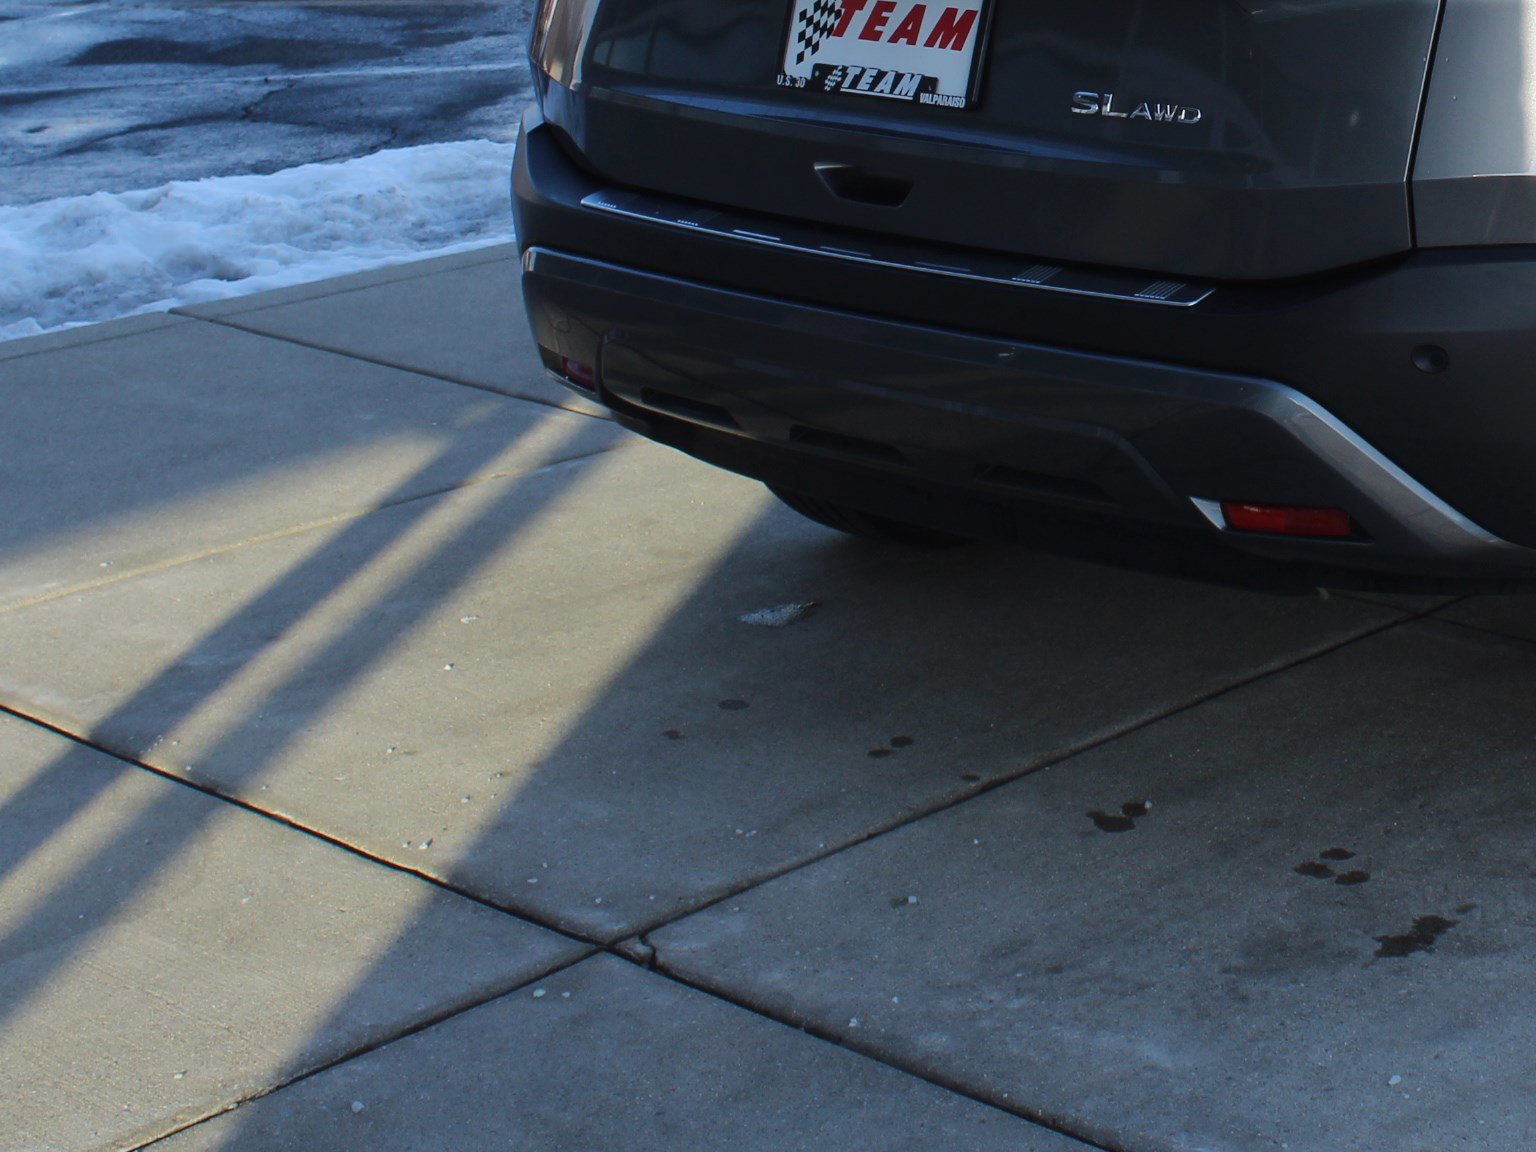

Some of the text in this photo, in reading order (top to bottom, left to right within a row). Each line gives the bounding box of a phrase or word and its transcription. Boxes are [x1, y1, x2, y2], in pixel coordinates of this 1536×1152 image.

[776, 74, 806, 89] U.S. 30
[842, 65, 923, 96] TEAM
[919, 92, 966, 108] VALPARAISO
